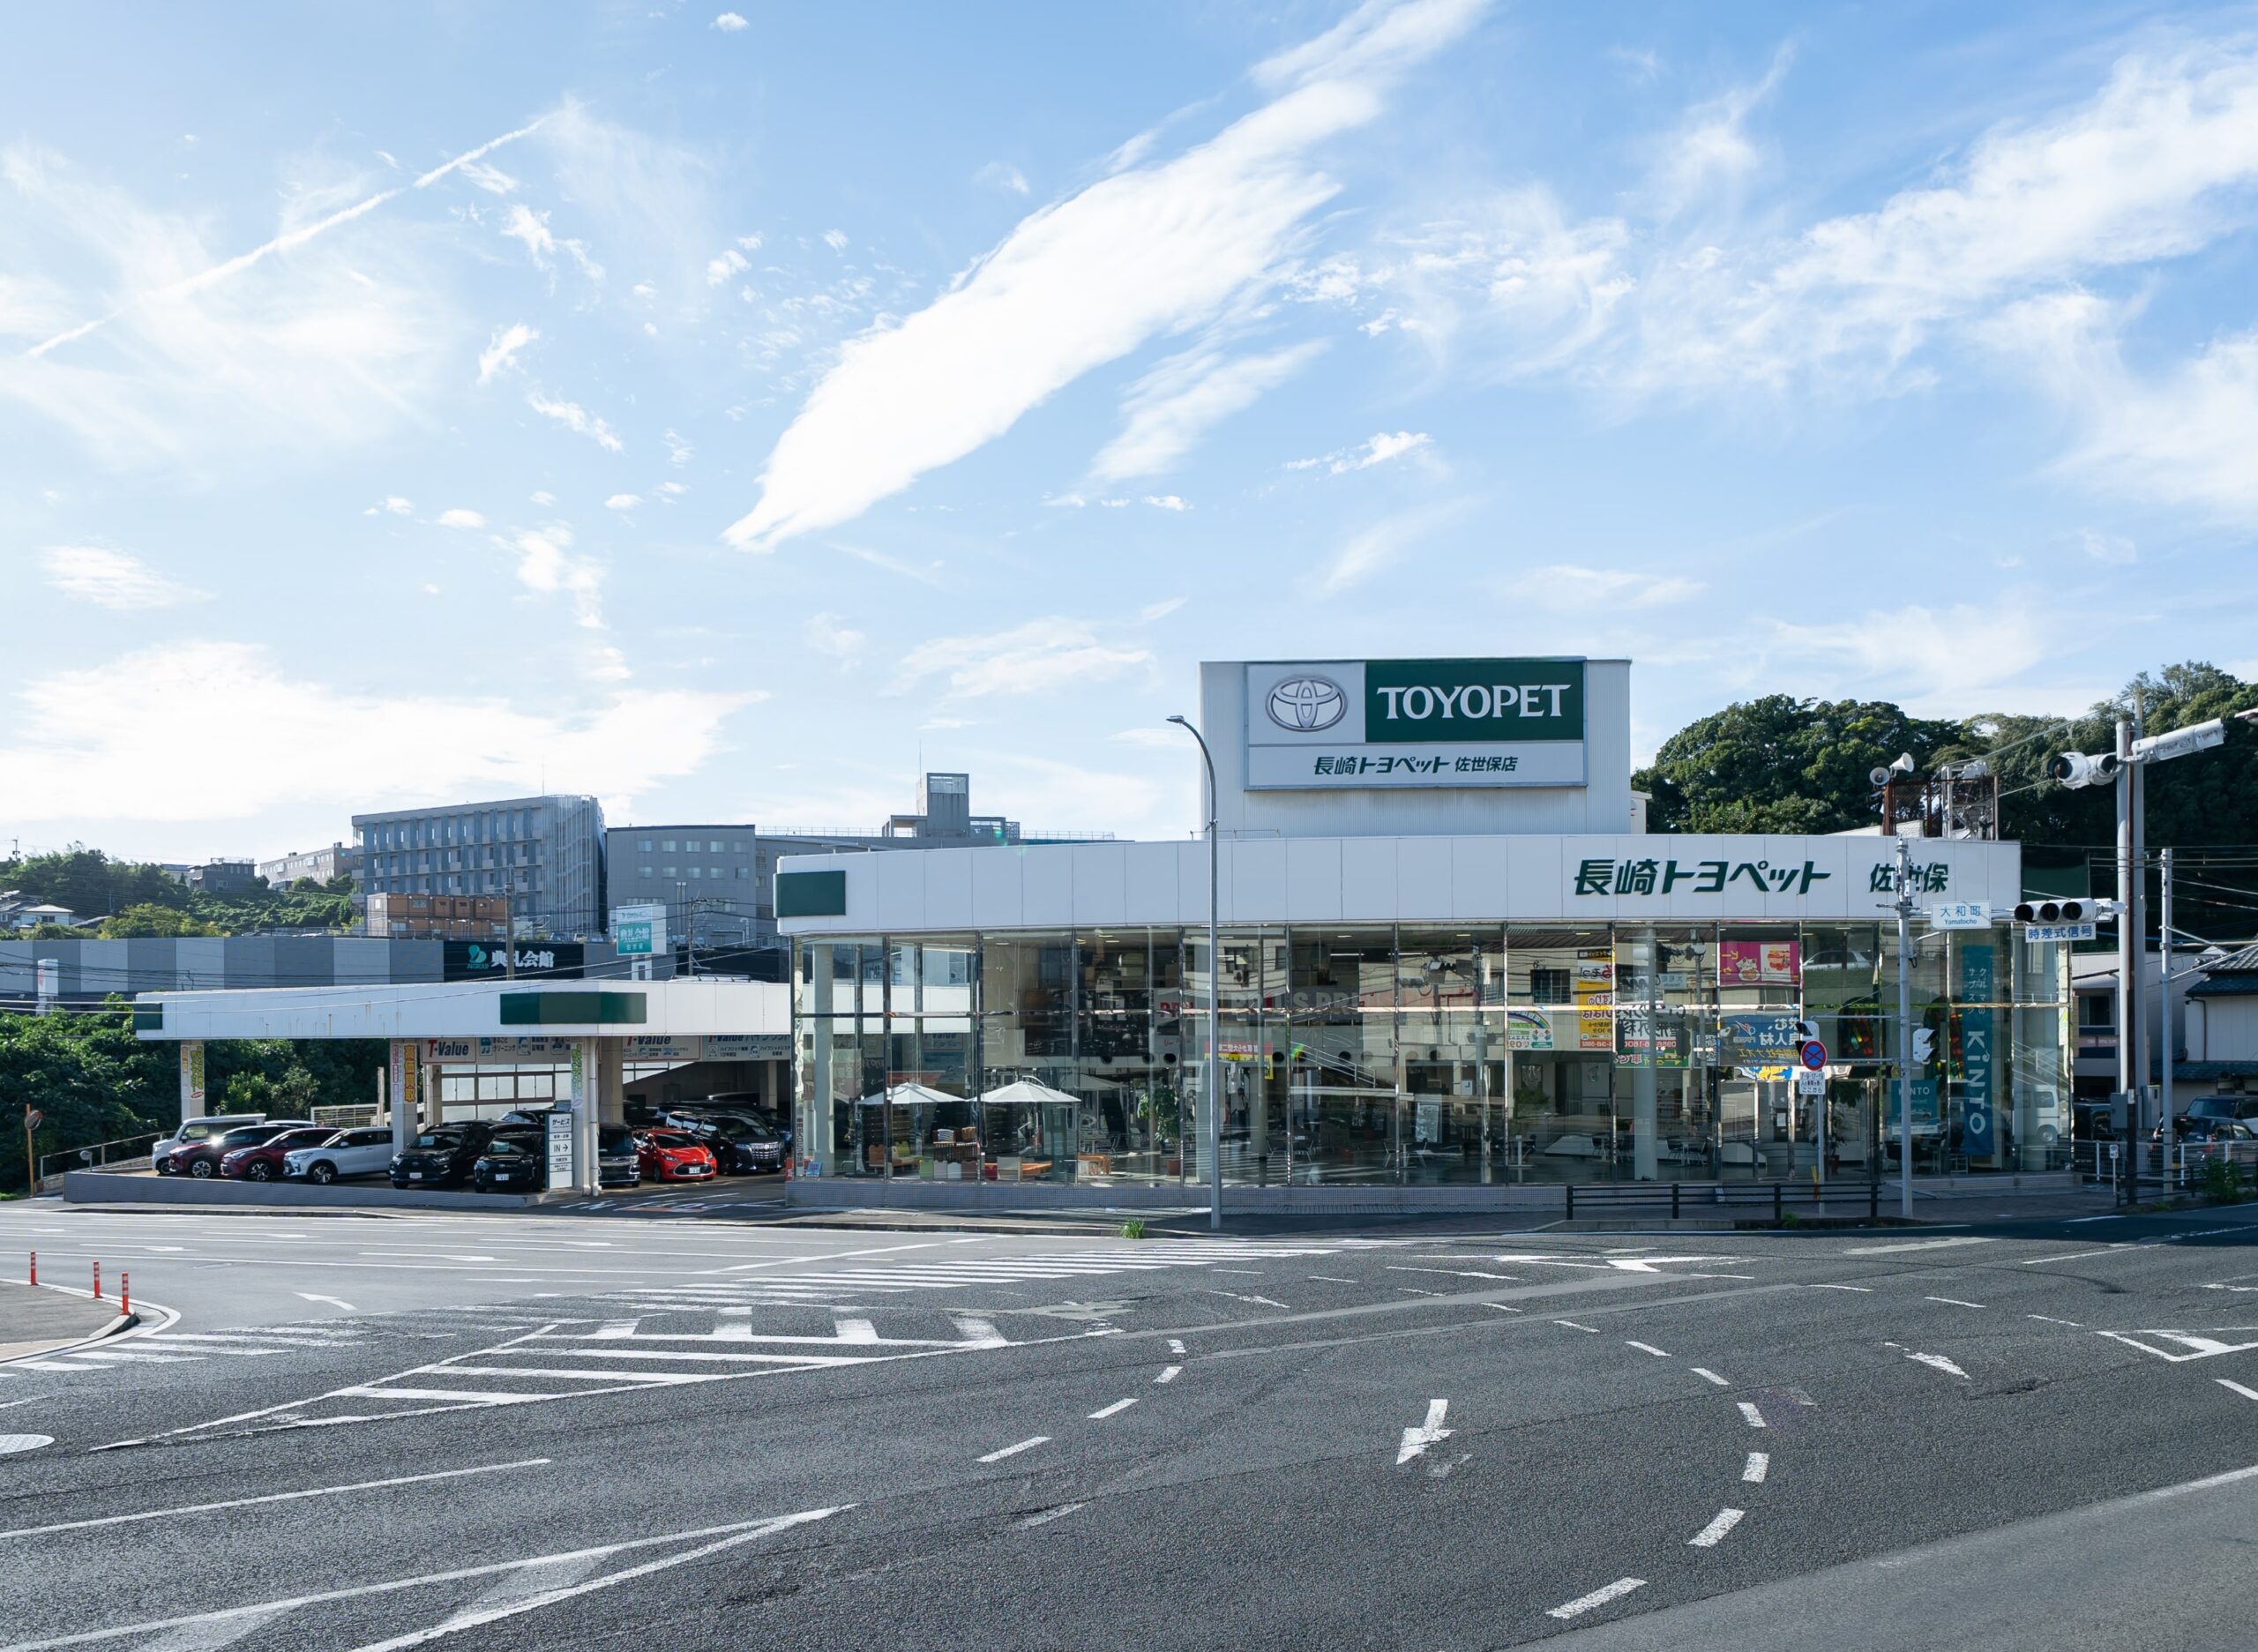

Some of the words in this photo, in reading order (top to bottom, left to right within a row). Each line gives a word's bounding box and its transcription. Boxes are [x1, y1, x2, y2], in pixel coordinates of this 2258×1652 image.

[1377, 684, 1571, 719] TOYOPET
[1313, 756, 1449, 775] 長崎トヨペット
[1454, 757, 1518, 773] 佐世保店
[1574, 859, 1831, 896] 長崎トヨペット
[1940, 905, 1981, 917] 大和町
[2029, 926, 2093, 939] 時差式信号
[404, 1044, 416, 1103] 高価買取
[1898, 1087, 1931, 1095] KNTO
[552, 1118, 571, 1126] サービス
[554, 1143, 561, 1153] IN
